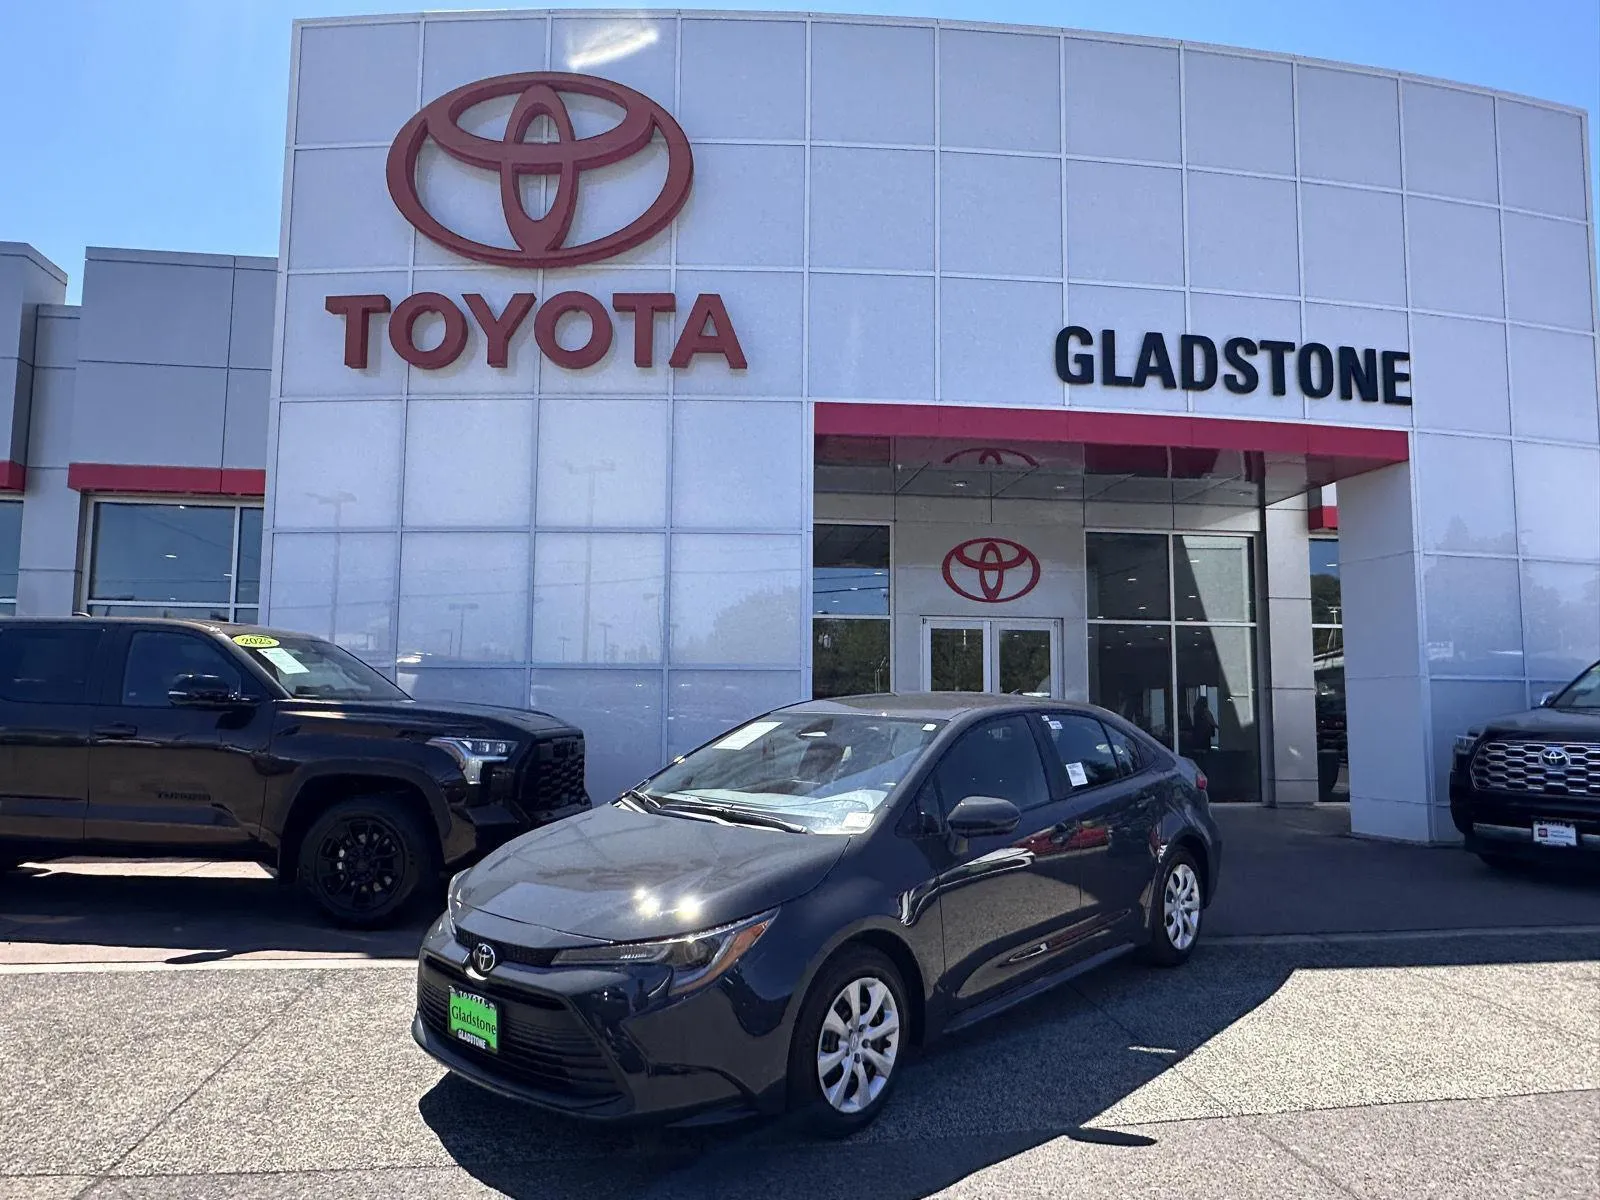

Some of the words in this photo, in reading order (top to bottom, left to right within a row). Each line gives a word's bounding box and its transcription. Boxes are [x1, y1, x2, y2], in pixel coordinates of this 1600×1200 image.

[325, 291, 748, 369] TOYOTA
[1055, 326, 1412, 406] GLADSTONE
[451, 1005, 496, 1034] Gladstone
